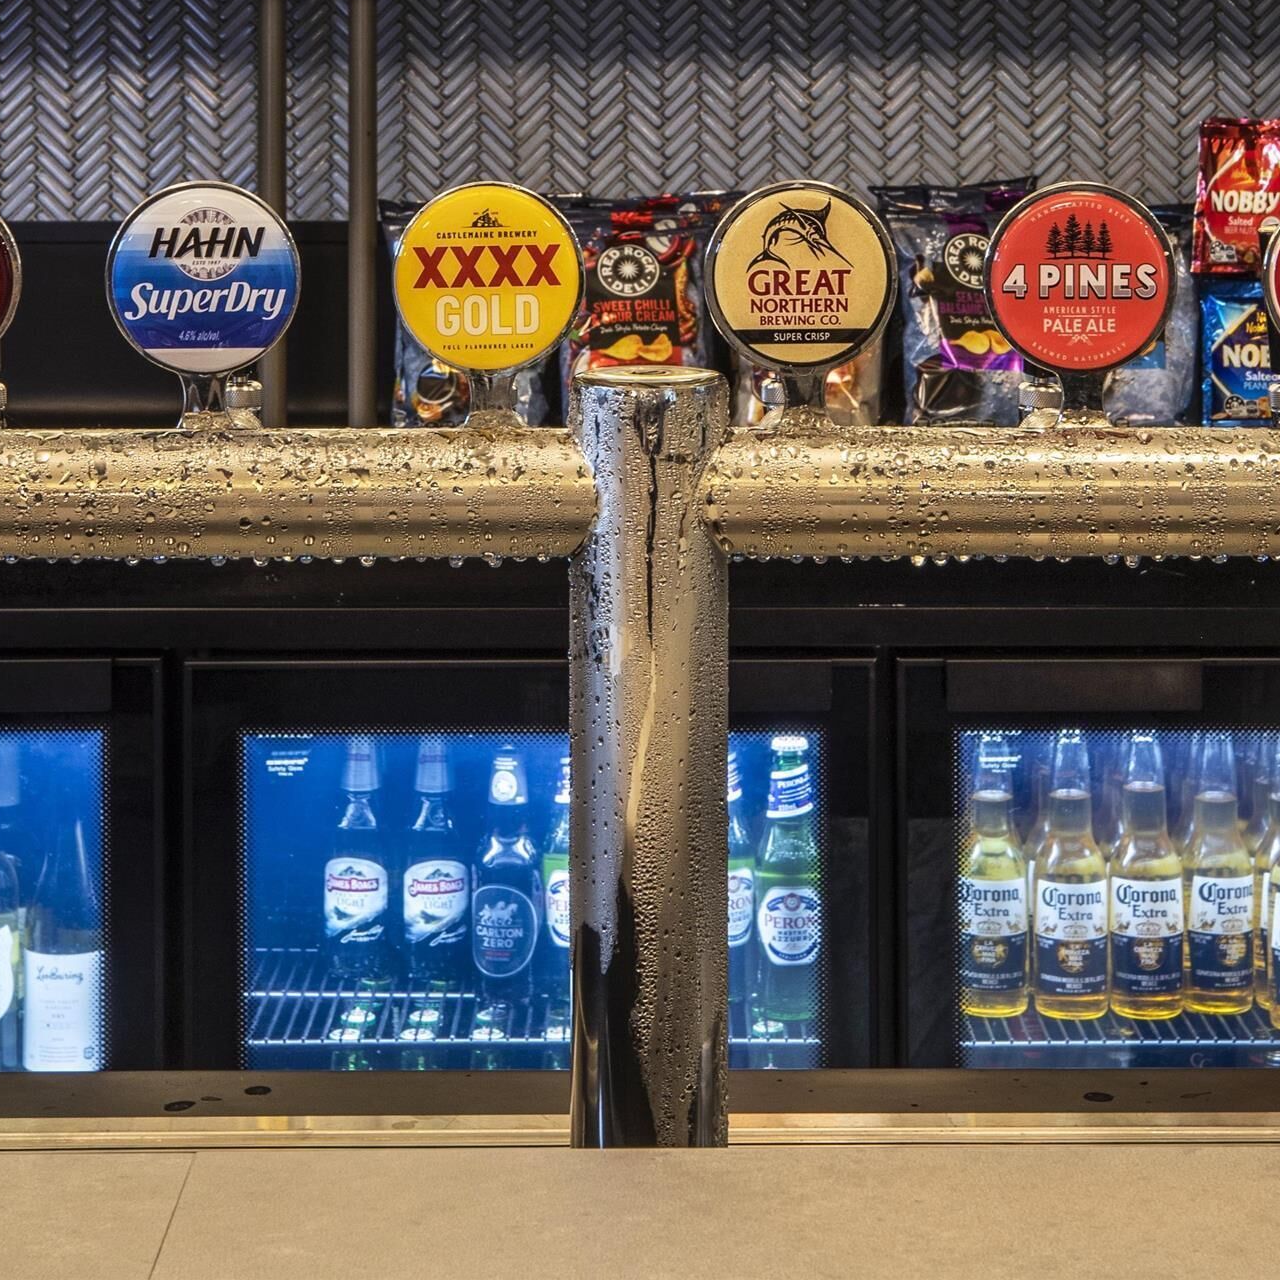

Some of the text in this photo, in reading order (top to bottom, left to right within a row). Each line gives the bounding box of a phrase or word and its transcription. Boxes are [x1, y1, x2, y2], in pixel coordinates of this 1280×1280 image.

[1031, 201, 1131, 224] HANDCRAFTED BEER
[1227, 216, 1255, 226] Salted
[148, 226, 266, 259] HAHN
[436, 230, 538, 240] CASTLEMAINE BREWERY
[412, 243, 562, 289] XXXX
[601, 246, 656, 277] RED ROCK
[611, 279, 650, 294] DELI
[746, 269, 852, 296] GREAT
[1001, 262, 1158, 300] 4 PINES
[124, 281, 287, 321] SuperDry
[593, 300, 671, 313] SWEET CHILLI
[750, 298, 849, 314] NORTHERN
[435, 293, 540, 336] GOLD
[636, 310, 675, 323] CREAM
[1043, 306, 1117, 314] AMERICAN STYLE
[759, 314, 842, 326] BREWING CO.
[1043, 318, 1117, 333] PALE ALE
[774, 331, 831, 342] SUPER CRISP
[1032, 342, 1128, 362] BREWED NATURALLY
[1042, 886, 1102, 910] Corona
[1116, 883, 1177, 907] Corona
[1058, 906, 1093, 920] Extra
[1132, 904, 1168, 918] Extra
[476, 925, 524, 938] CARLTON
[483, 937, 514, 949] ZERO
